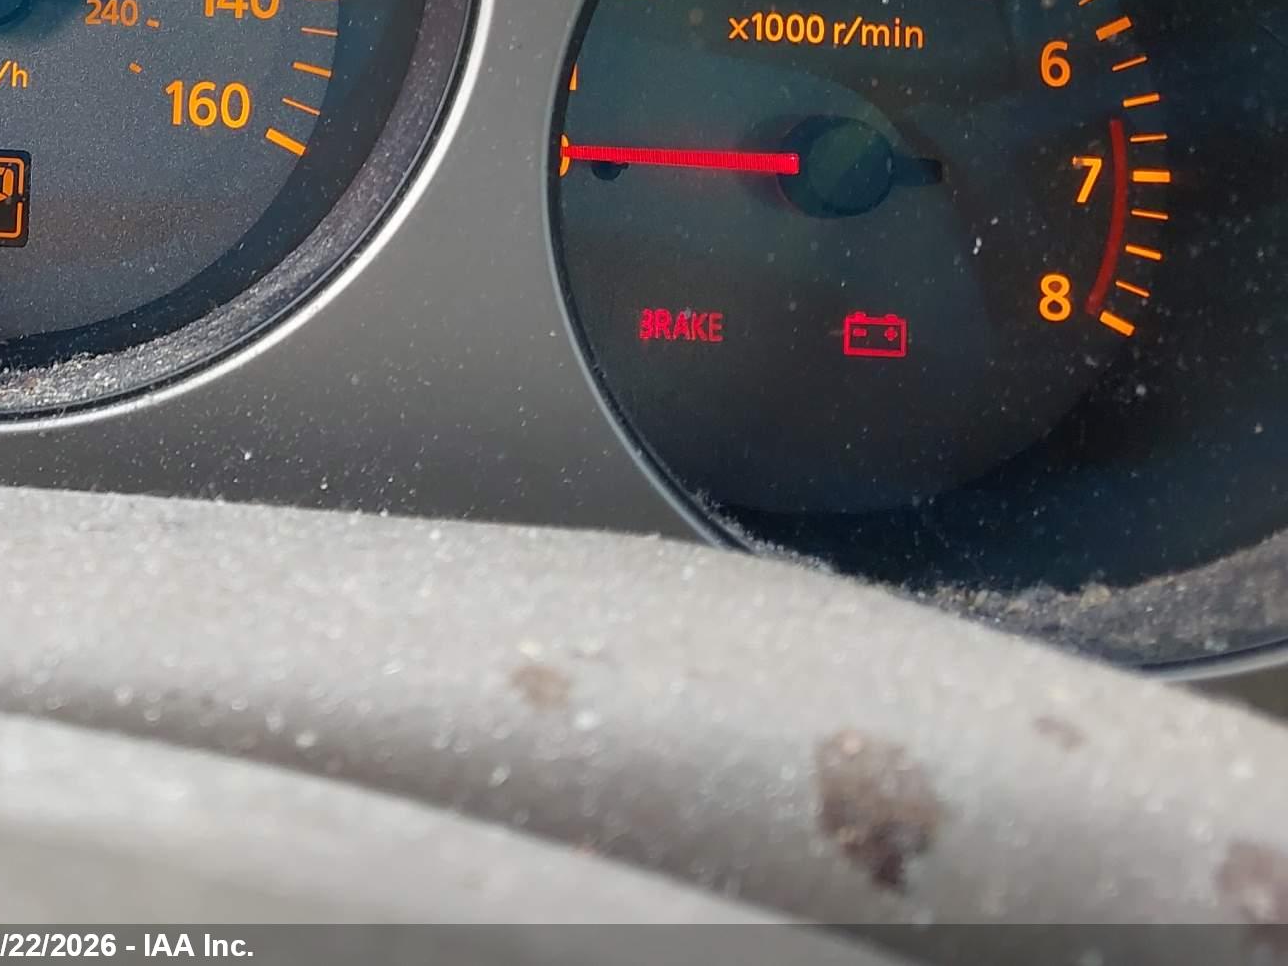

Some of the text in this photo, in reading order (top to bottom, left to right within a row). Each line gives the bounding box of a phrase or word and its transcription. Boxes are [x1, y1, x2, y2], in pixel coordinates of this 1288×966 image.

[728, 10, 924, 49] x1000 r/min
[1040, 40, 1071, 88] 6
[166, 80, 252, 130] 160
[1072, 155, 1103, 204] 7
[1039, 272, 1072, 322] 8
[639, 308, 723, 342] BRAKE
